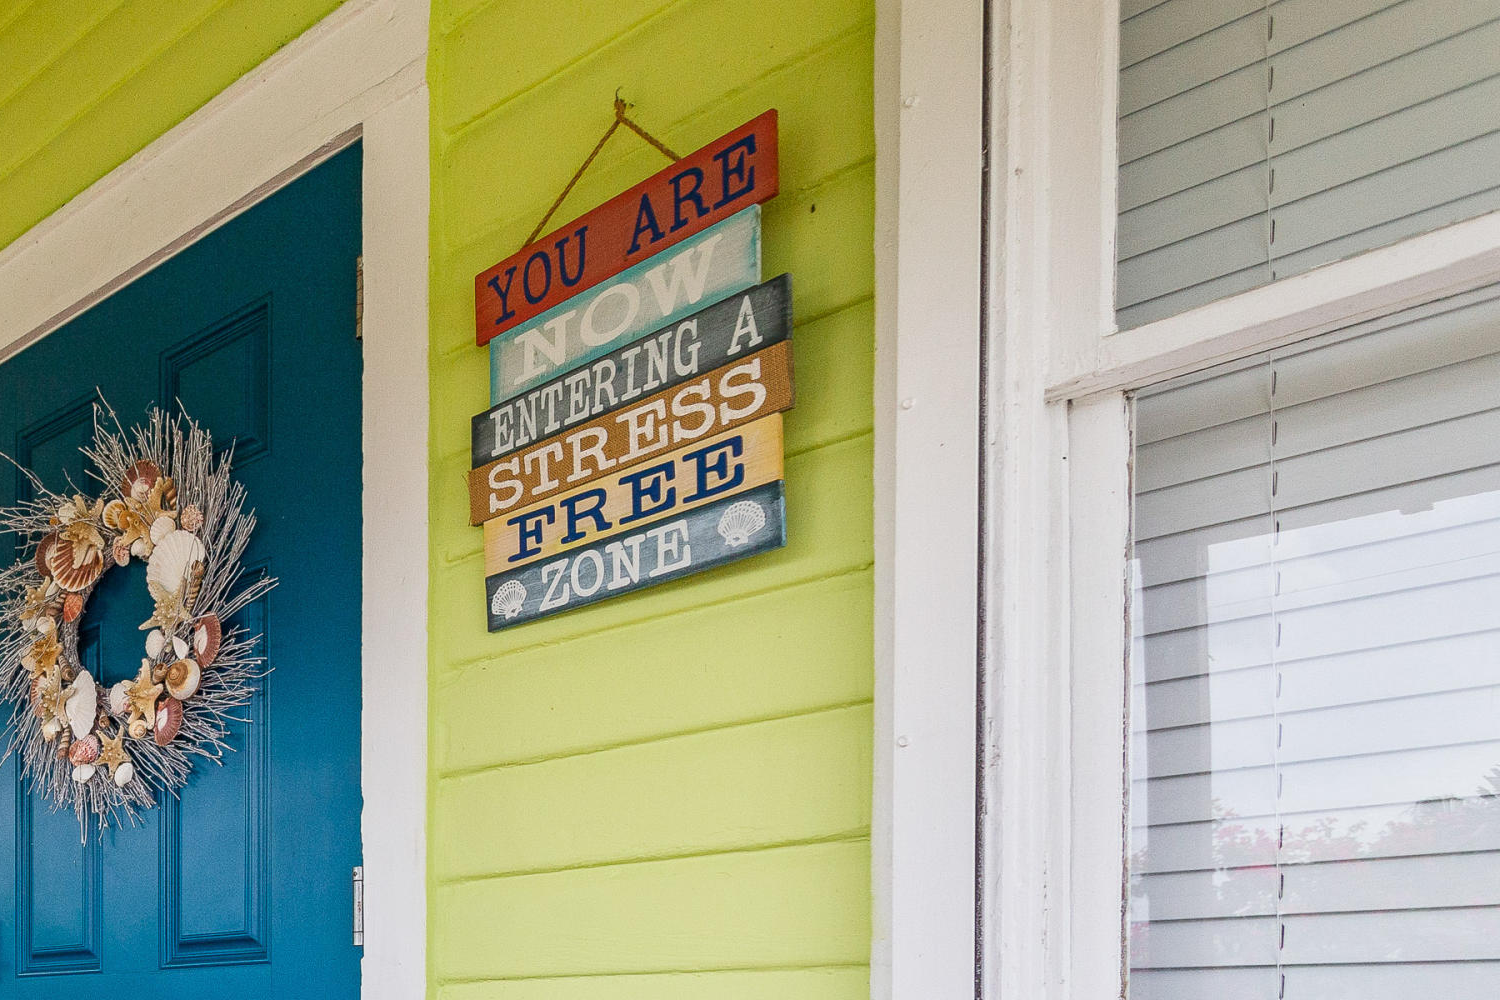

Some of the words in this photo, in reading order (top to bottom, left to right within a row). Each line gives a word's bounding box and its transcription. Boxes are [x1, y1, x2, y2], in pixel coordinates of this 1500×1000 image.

[487, 225, 589, 326] YOU
[626, 133, 758, 257] ARE
[489, 318, 702, 457] ENTERING
[727, 295, 764, 356] A
[513, 233, 723, 386] NOW
[488, 357, 767, 514] STRESS
[507, 435, 746, 563] FREE
[538, 518, 692, 612] ZONE
